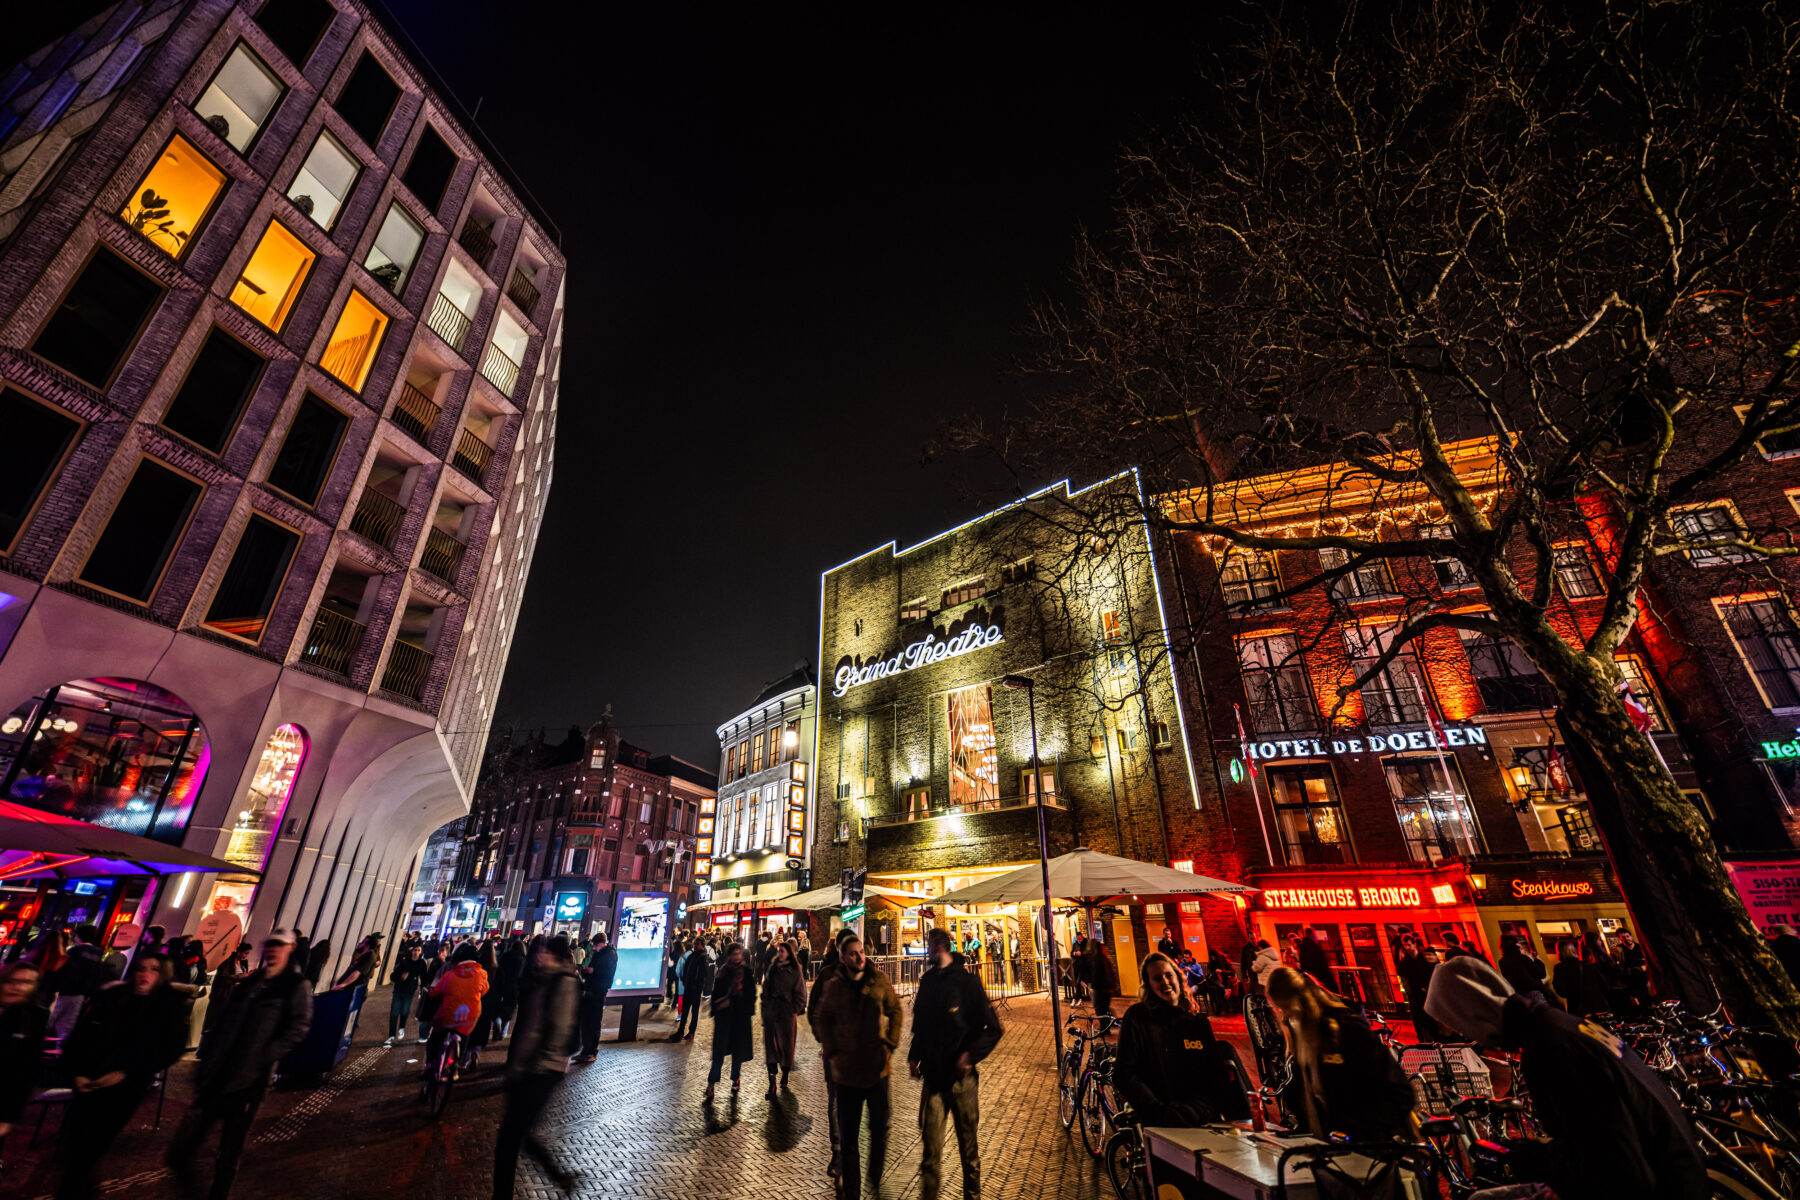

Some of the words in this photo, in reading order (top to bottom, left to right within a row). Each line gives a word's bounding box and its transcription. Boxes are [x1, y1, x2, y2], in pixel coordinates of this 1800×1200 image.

[832, 652, 904, 697] Grand
[905, 623, 1003, 668] Theatre
[1241, 739, 1327, 759] HOTEL
[1332, 740, 1363, 754] DE
[1368, 727, 1488, 752] DOELEN
[790, 763, 804, 855] HOEK
[695, 798, 714, 874] HOEK
[1264, 887, 1356, 908] STEAKHOUSE
[1359, 886, 1421, 907] BRONCO
[1511, 878, 1593, 899] Steakhouse
[1766, 914, 1788, 924] GET
